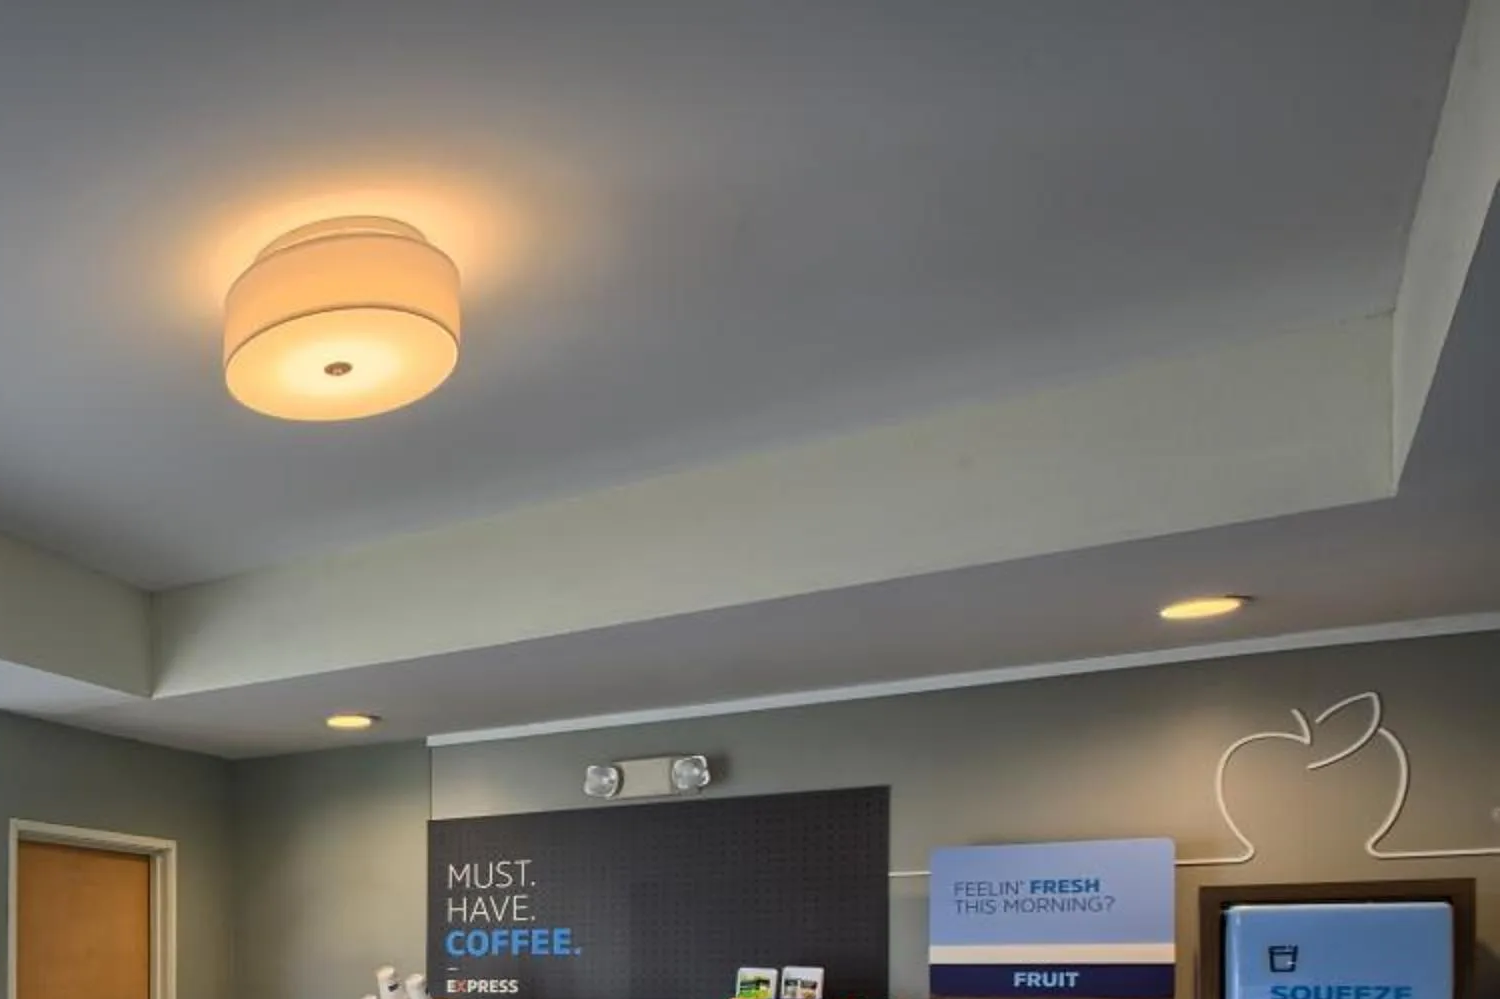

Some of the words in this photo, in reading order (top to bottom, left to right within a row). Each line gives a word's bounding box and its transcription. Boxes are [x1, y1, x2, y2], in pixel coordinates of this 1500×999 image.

[447, 859, 537, 889] MUST.
[1029, 878, 1100, 895] FRESH
[447, 894, 536, 922] HAVE.
[954, 899, 997, 915] THIS
[1003, 895, 1116, 914] MORNING?
[446, 927, 582, 957] COFFEE.
[446, 978, 519, 993] EXPRESS
[1013, 971, 1080, 987] FRUIT
